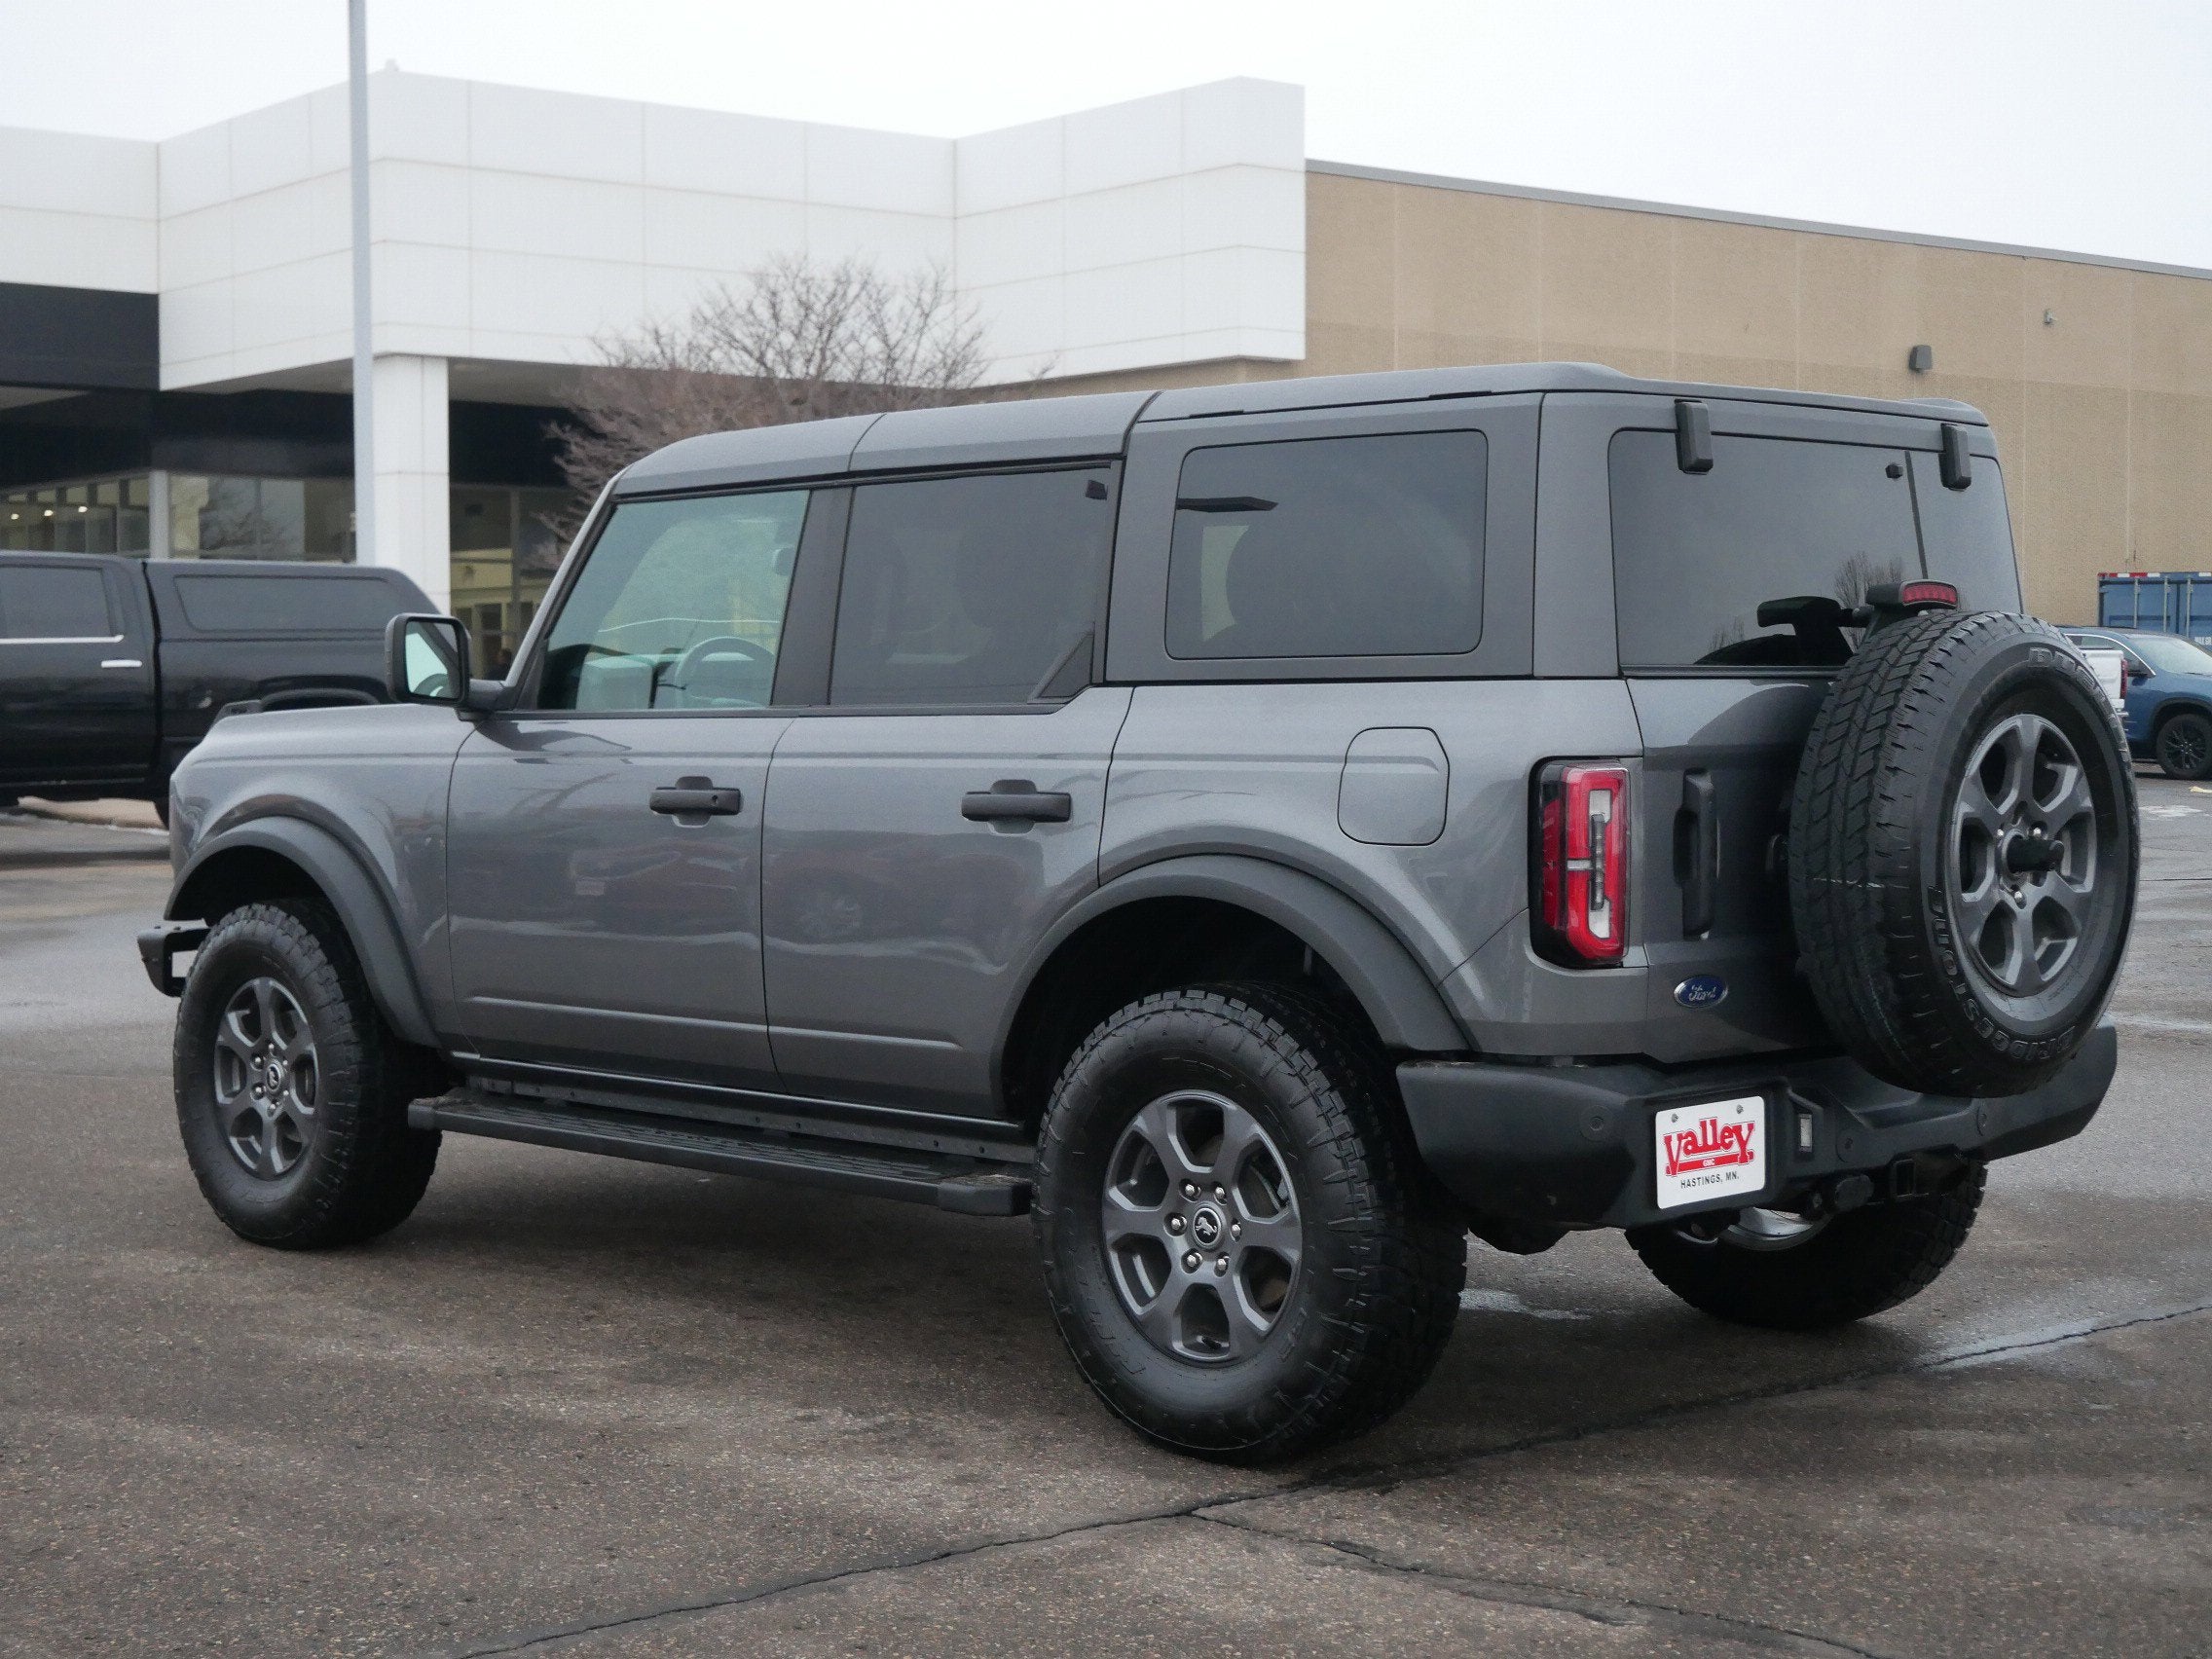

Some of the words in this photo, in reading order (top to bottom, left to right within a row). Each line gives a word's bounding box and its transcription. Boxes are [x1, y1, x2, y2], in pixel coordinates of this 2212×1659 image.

[1688, 984, 1716, 1002] Ford
[1702, 1158, 1715, 1167] GMC
[1680, 1172, 1723, 1189] HASTINGS,
[1725, 1170, 1740, 1181] MN.
